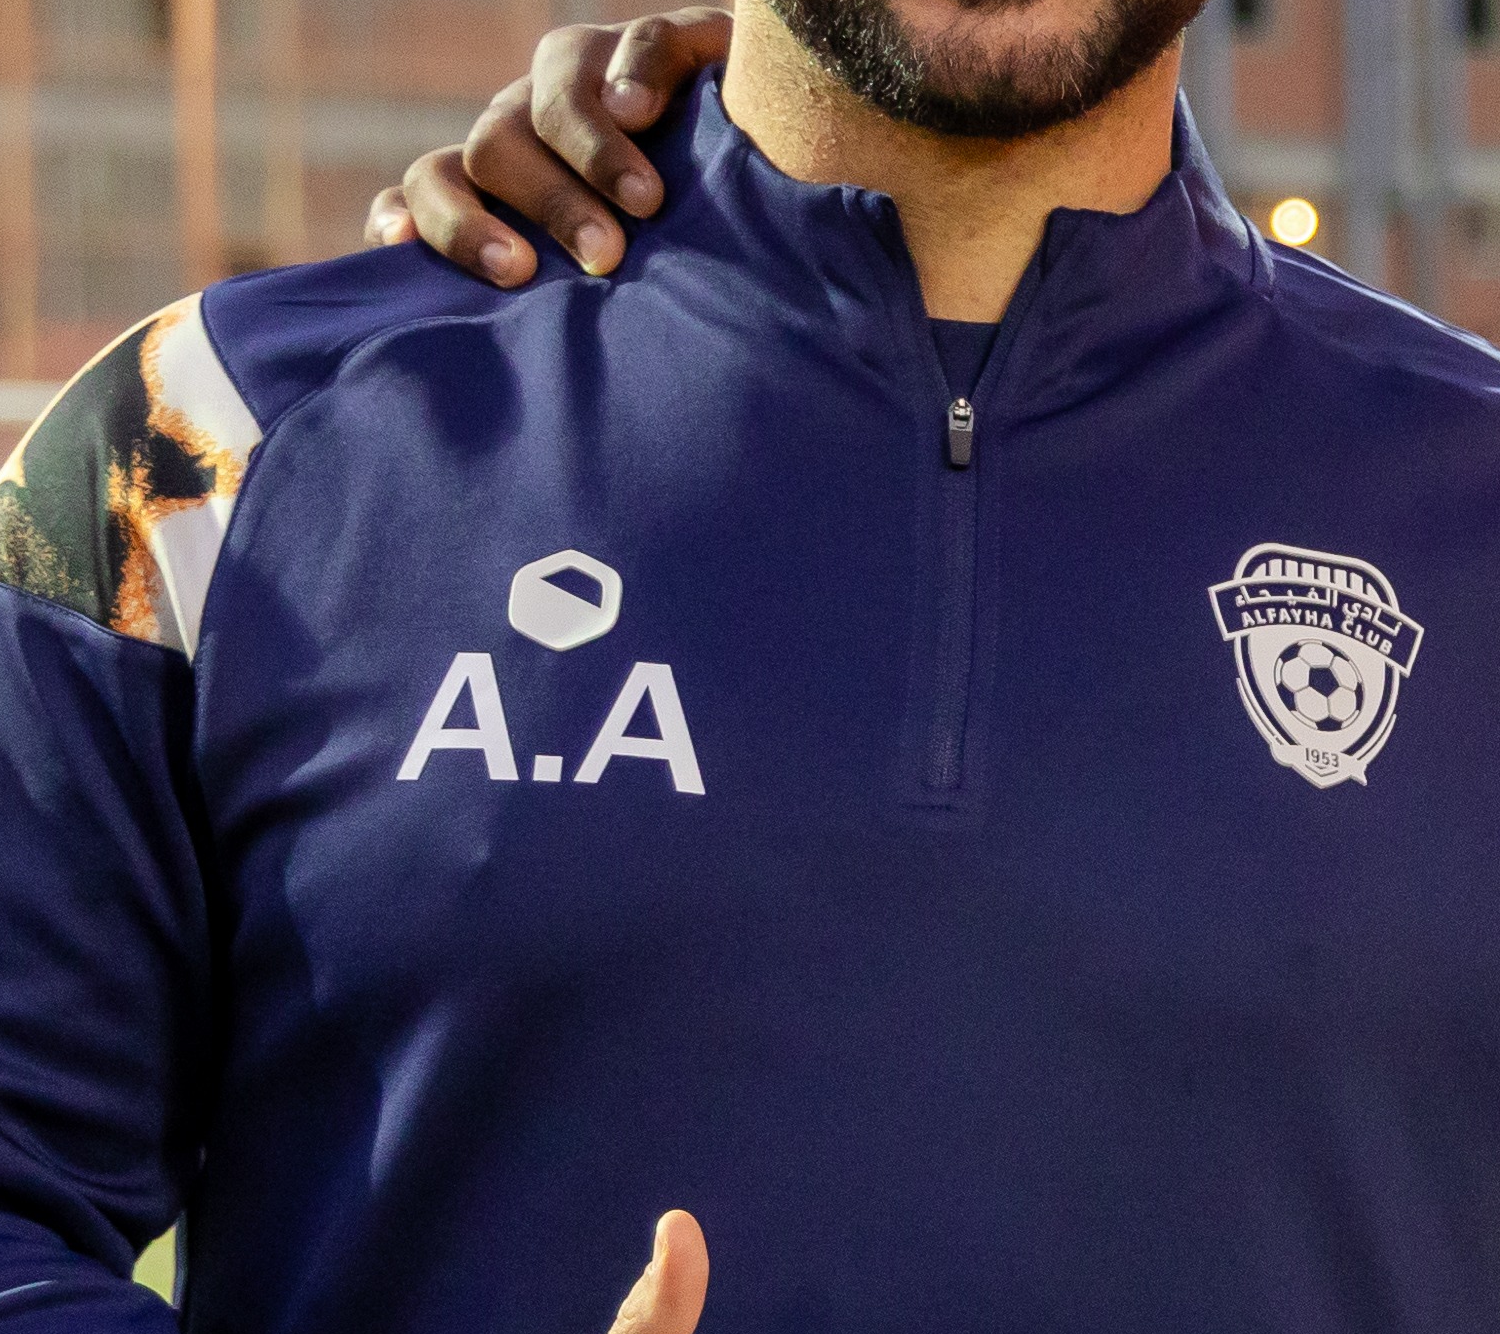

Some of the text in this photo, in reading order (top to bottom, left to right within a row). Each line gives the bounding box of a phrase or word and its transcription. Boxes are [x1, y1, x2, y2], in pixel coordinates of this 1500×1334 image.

[1235, 585, 1338, 609] الفيحاء
[1241, 608, 1393, 655] ALFAYHA CLUB
[396, 651, 706, 795] A.A
[1305, 747, 1340, 768] 1953
